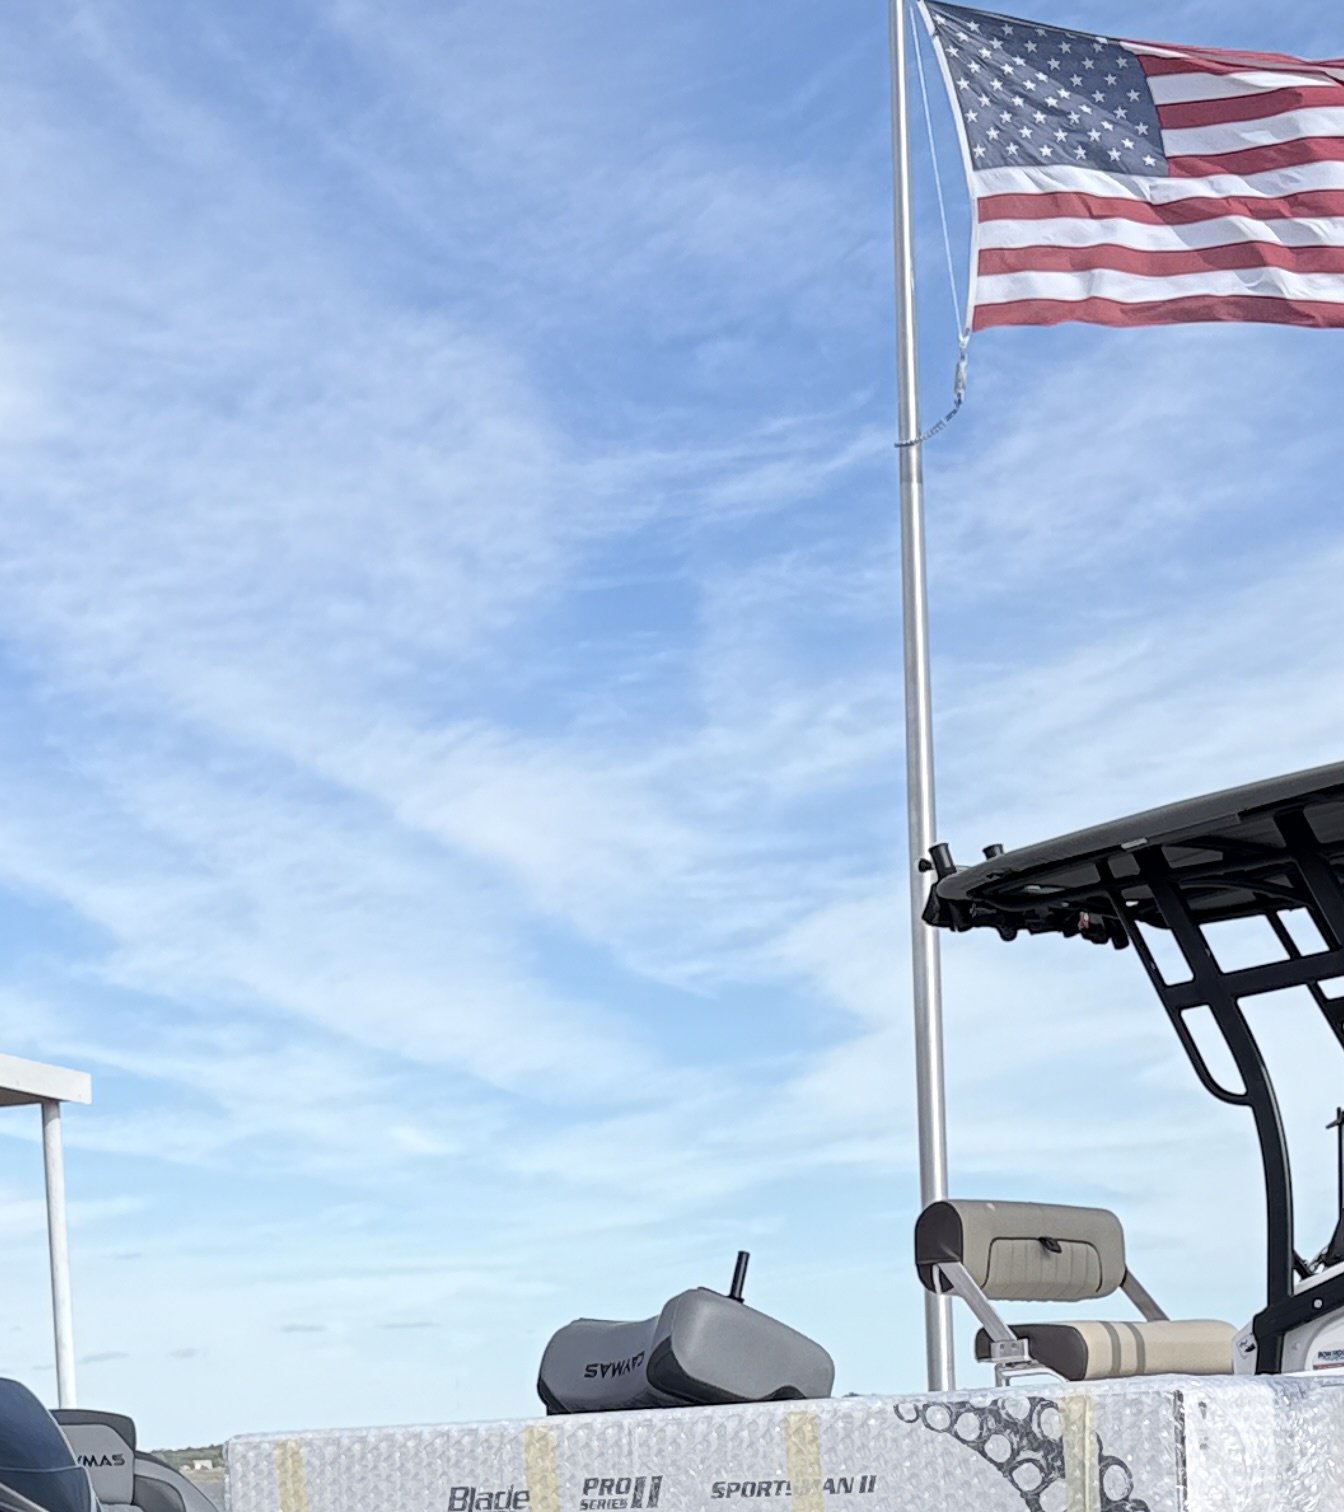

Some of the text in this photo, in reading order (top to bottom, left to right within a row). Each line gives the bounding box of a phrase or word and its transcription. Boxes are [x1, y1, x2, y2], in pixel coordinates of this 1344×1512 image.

[583, 1350, 645, 1379] CAYMAS
[77, 1453, 126, 1467] MAS
[583, 1476, 632, 1496] PRO
[858, 1475, 878, 1494] II
